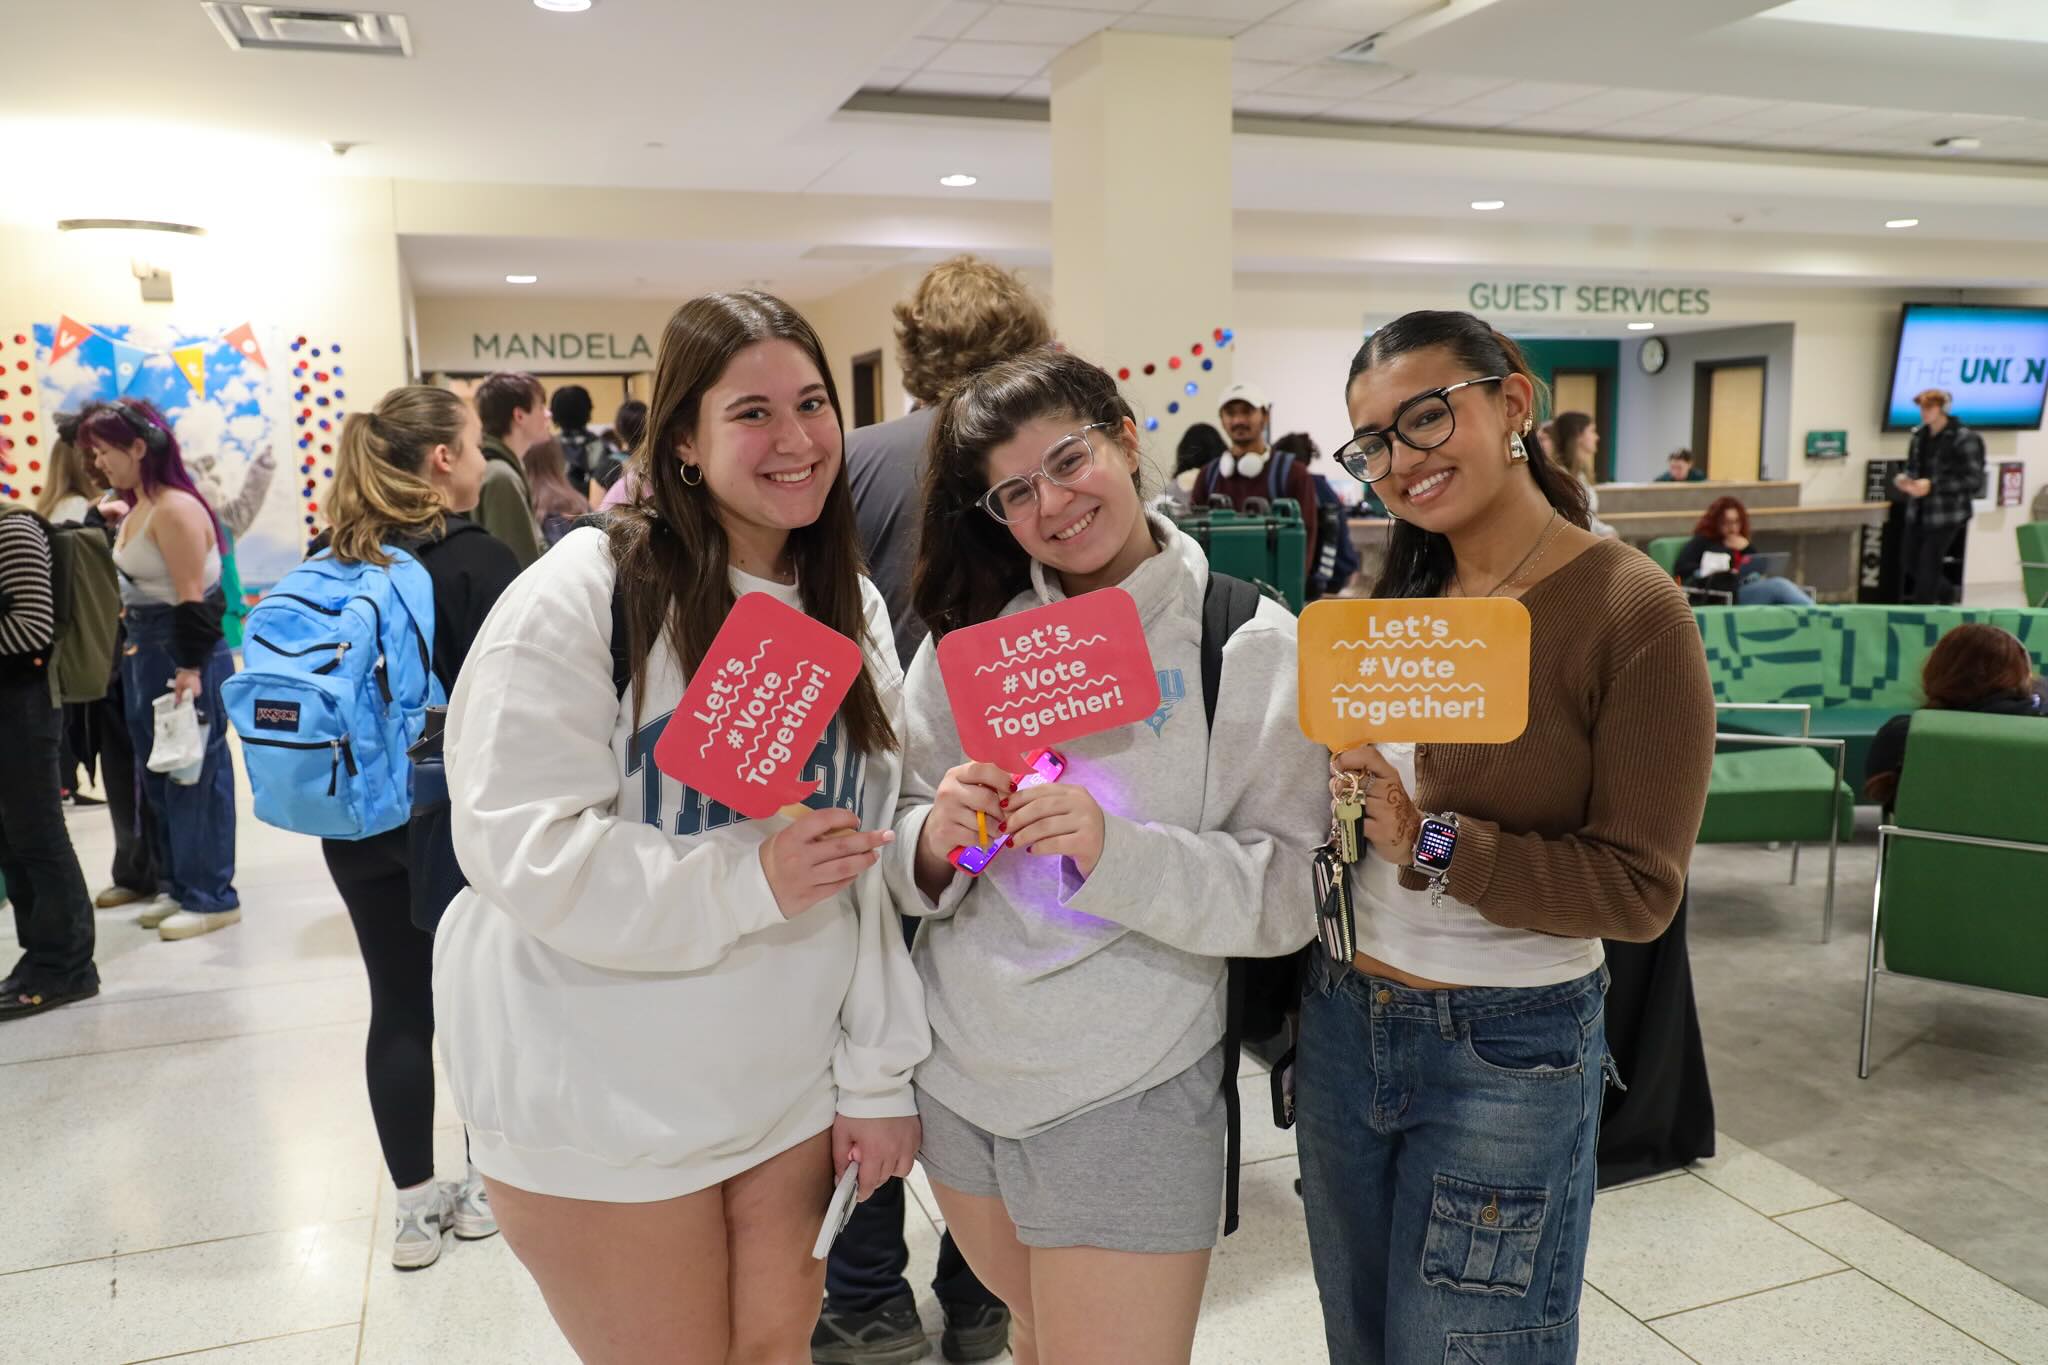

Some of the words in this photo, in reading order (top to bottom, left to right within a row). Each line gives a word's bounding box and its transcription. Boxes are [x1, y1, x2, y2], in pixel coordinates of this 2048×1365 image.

[1469, 283, 1566, 312] GUEST
[1576, 286, 1711, 315] SERVICES
[473, 333, 653, 359] MANDELA
[1902, 356, 1955, 385] THE
[1000, 624, 1072, 657] Let's
[1368, 615, 1449, 638] Let's
[1002, 660, 1087, 694] #Vote
[1358, 656, 1455, 678] #Vote
[693, 658, 745, 725] Let's
[726, 672, 782, 749] #Vote
[746, 664, 832, 785] Together!
[987, 685, 1124, 738] Together!
[1331, 694, 1485, 725] Together!
